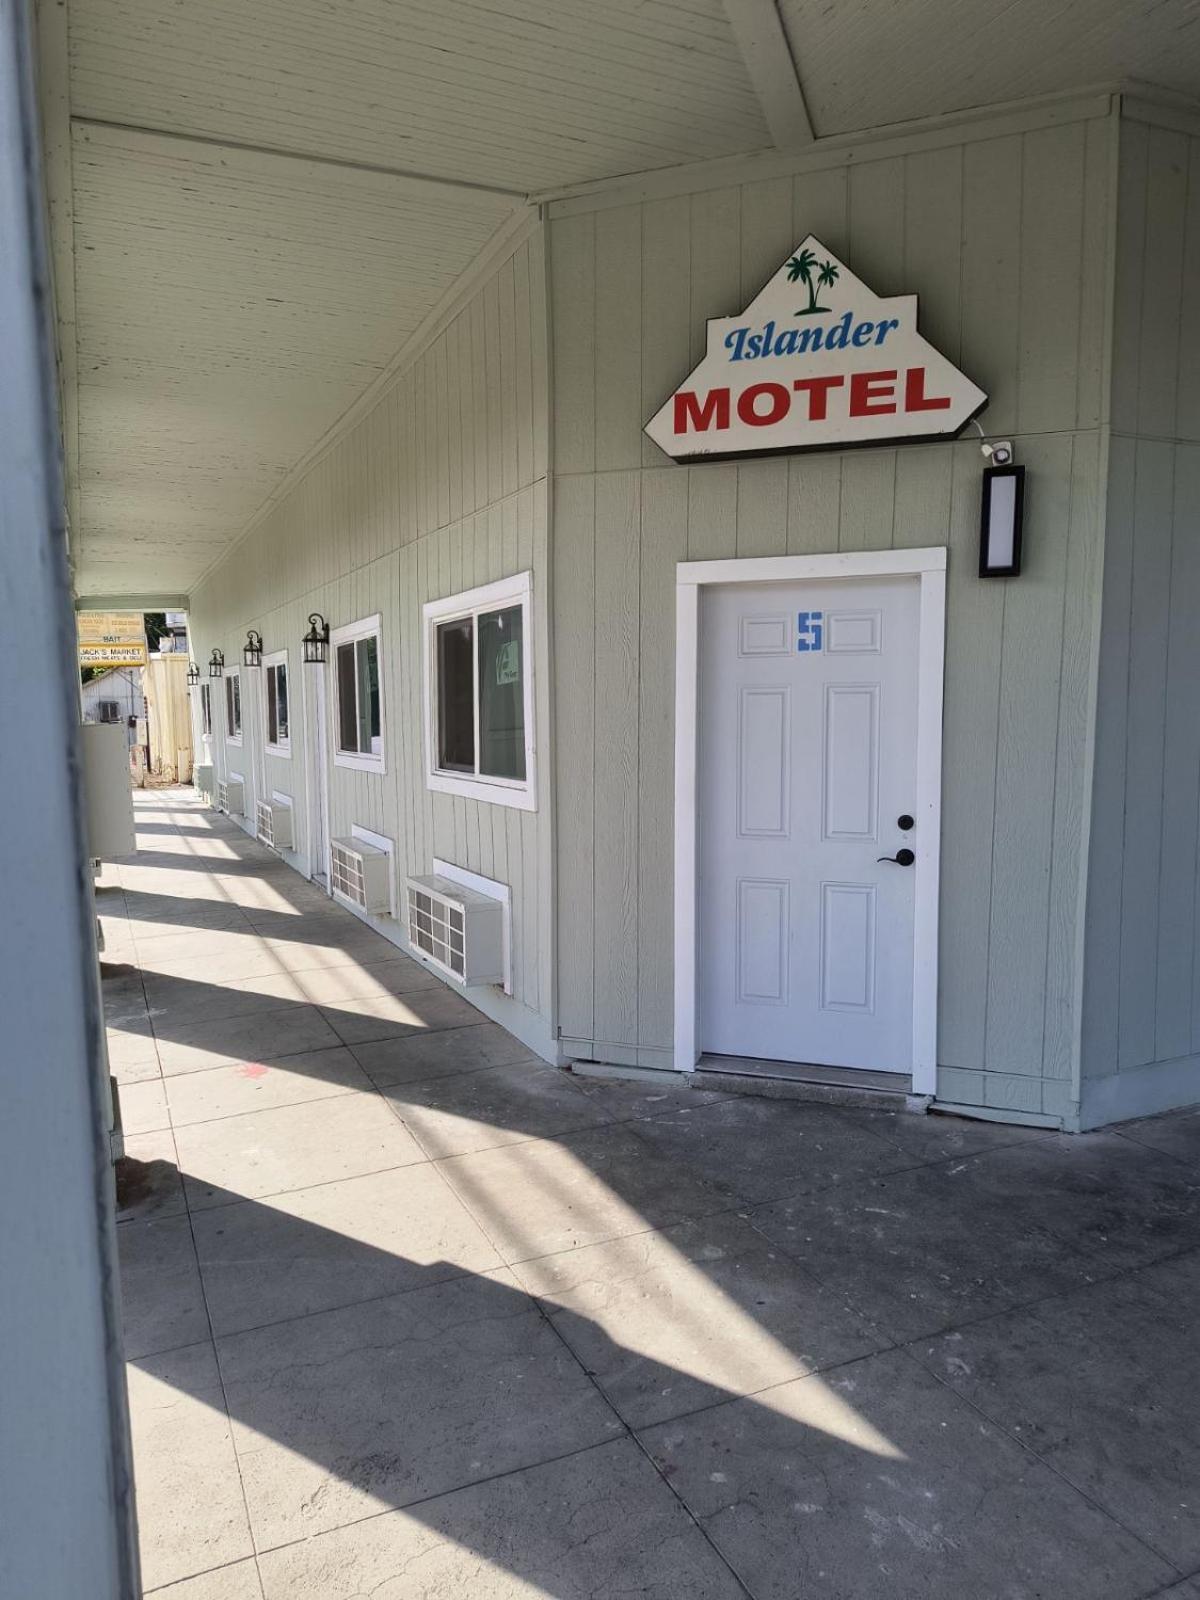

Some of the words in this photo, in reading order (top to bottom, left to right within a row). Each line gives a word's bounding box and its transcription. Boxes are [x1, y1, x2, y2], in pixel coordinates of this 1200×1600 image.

[724, 312, 899, 362] Islander
[673, 367, 951, 434] MOTEL
[797, 611, 823, 652] 5
